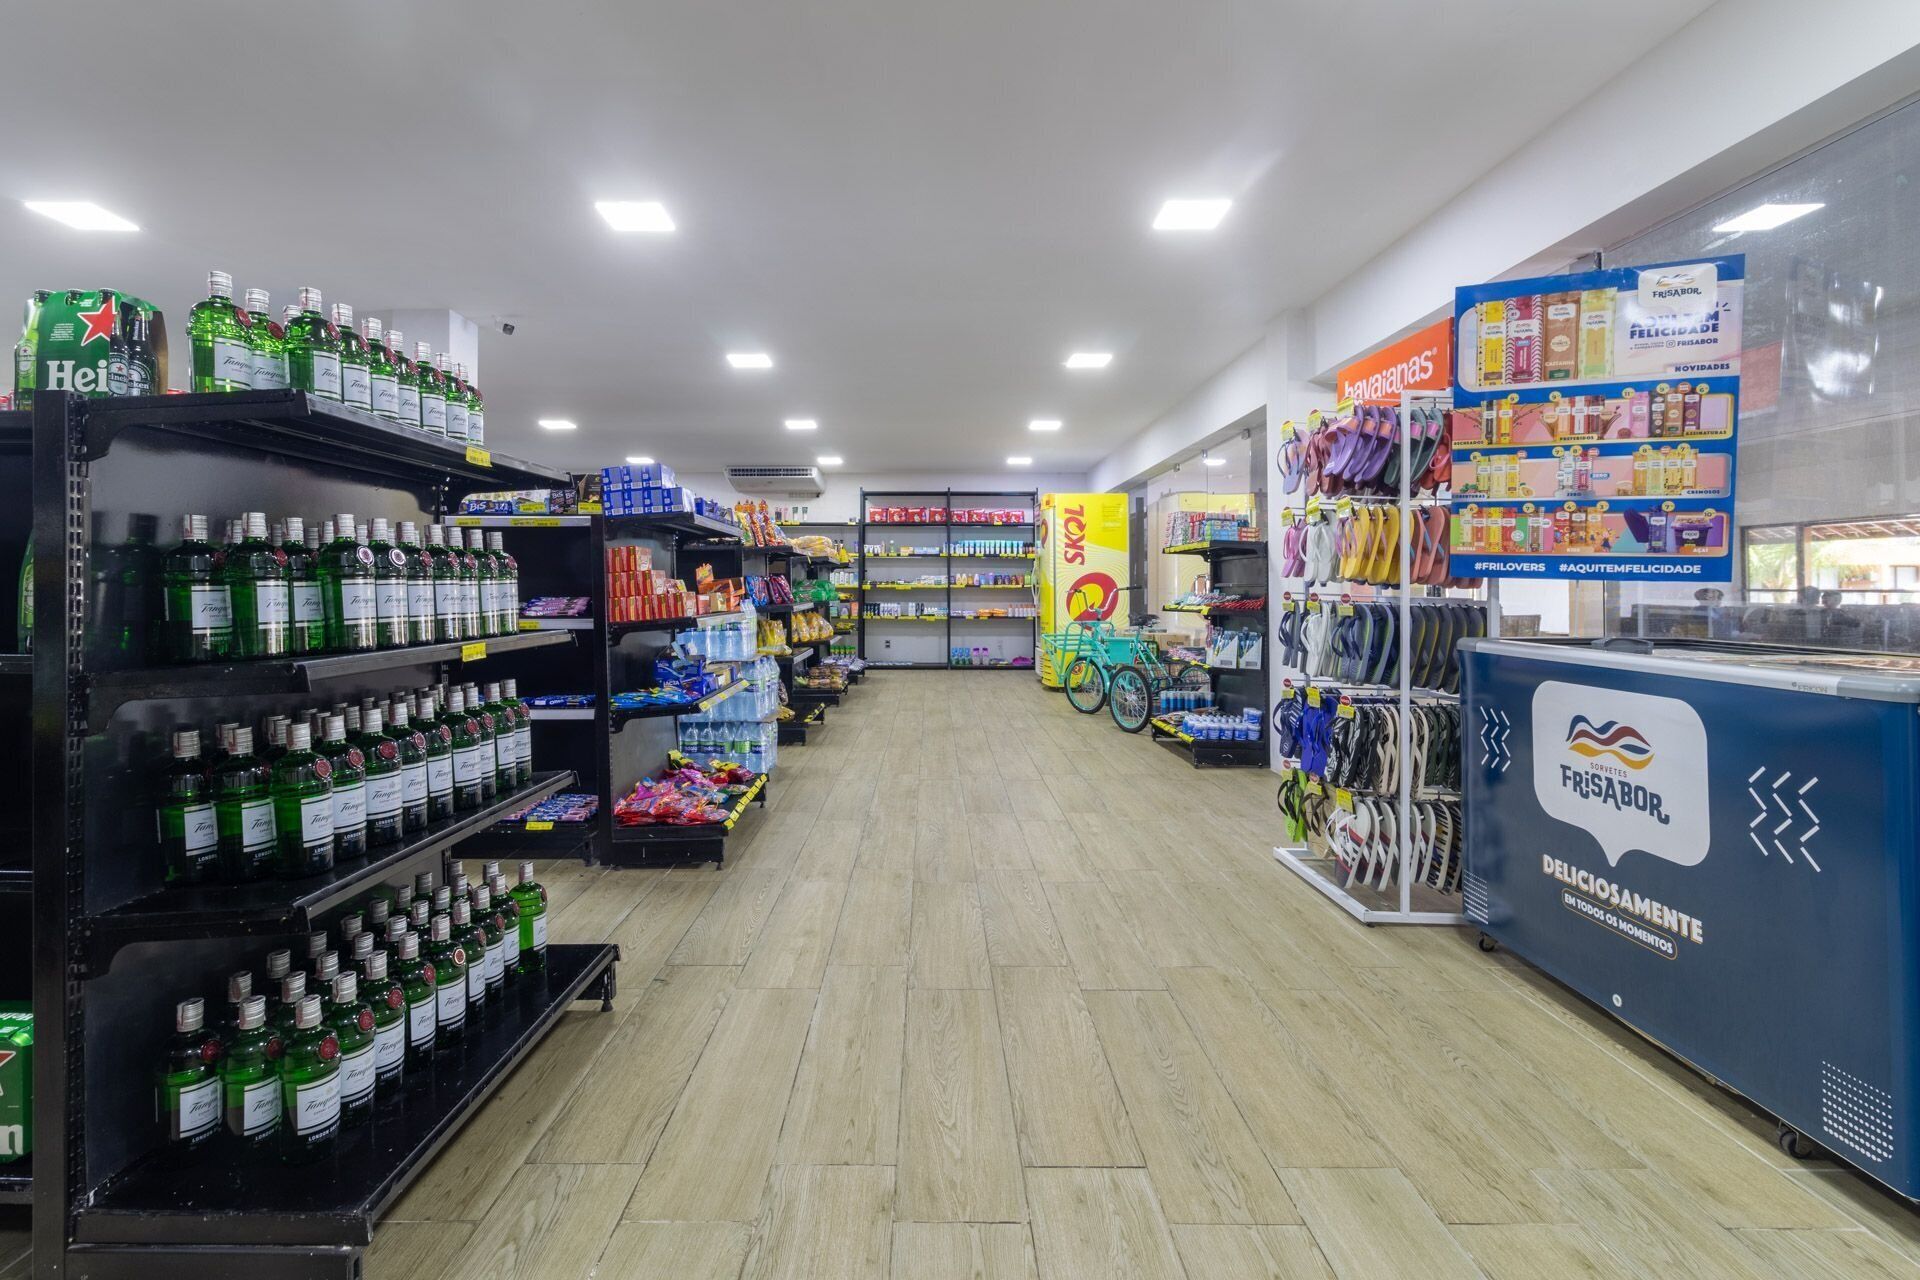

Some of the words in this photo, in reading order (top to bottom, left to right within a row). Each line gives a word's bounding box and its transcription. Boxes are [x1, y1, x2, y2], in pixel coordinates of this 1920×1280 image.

[1630, 323, 1720, 339] FELICIDADE
[1677, 338, 1719, 347] FRISABOR
[1674, 363, 1730, 373] NOVIDADES
[1474, 562, 1546, 572] #FRILOVERS
[1559, 563, 1702, 574] #AQUITEMFELICIDADE
[1590, 762, 1628, 778] SORVETES
[1542, 853, 1704, 945] DELICIOSAMENTE
[1564, 892, 1577, 908] EM
[1576, 898, 1605, 921] TODOS
[1605, 913, 1618, 928] OS
[1618, 918, 1674, 955] MOMENTOS
